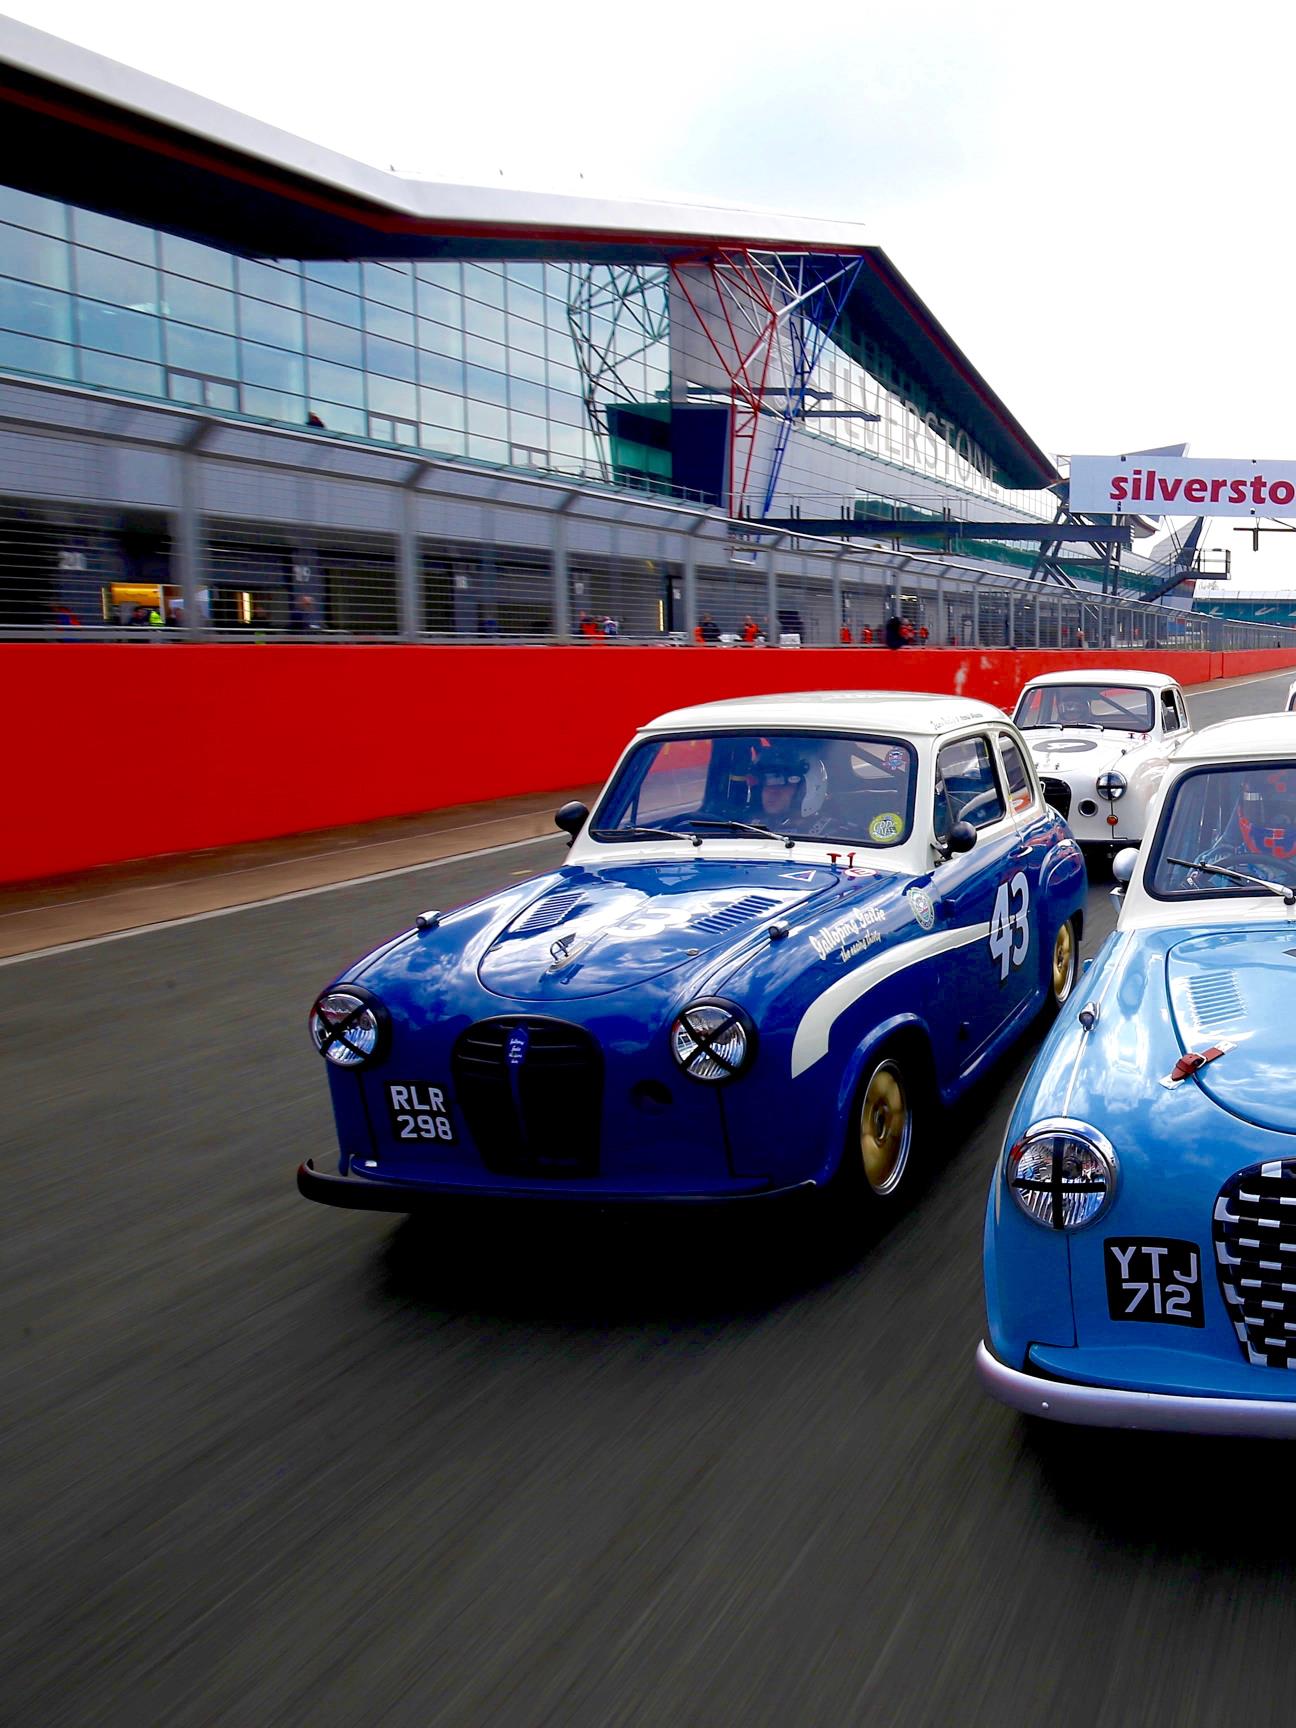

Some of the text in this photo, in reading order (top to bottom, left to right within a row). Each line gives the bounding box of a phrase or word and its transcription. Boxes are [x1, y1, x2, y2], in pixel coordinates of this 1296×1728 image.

[808, 920, 859, 960] Galloping
[852, 907, 886, 927] Gertie
[989, 871, 1029, 980] 43
[390, 1085, 446, 1113] RLR
[397, 1115, 452, 1140] 298
[1110, 1246, 1198, 1284] YTJ
[1122, 1282, 1192, 1318] 712
